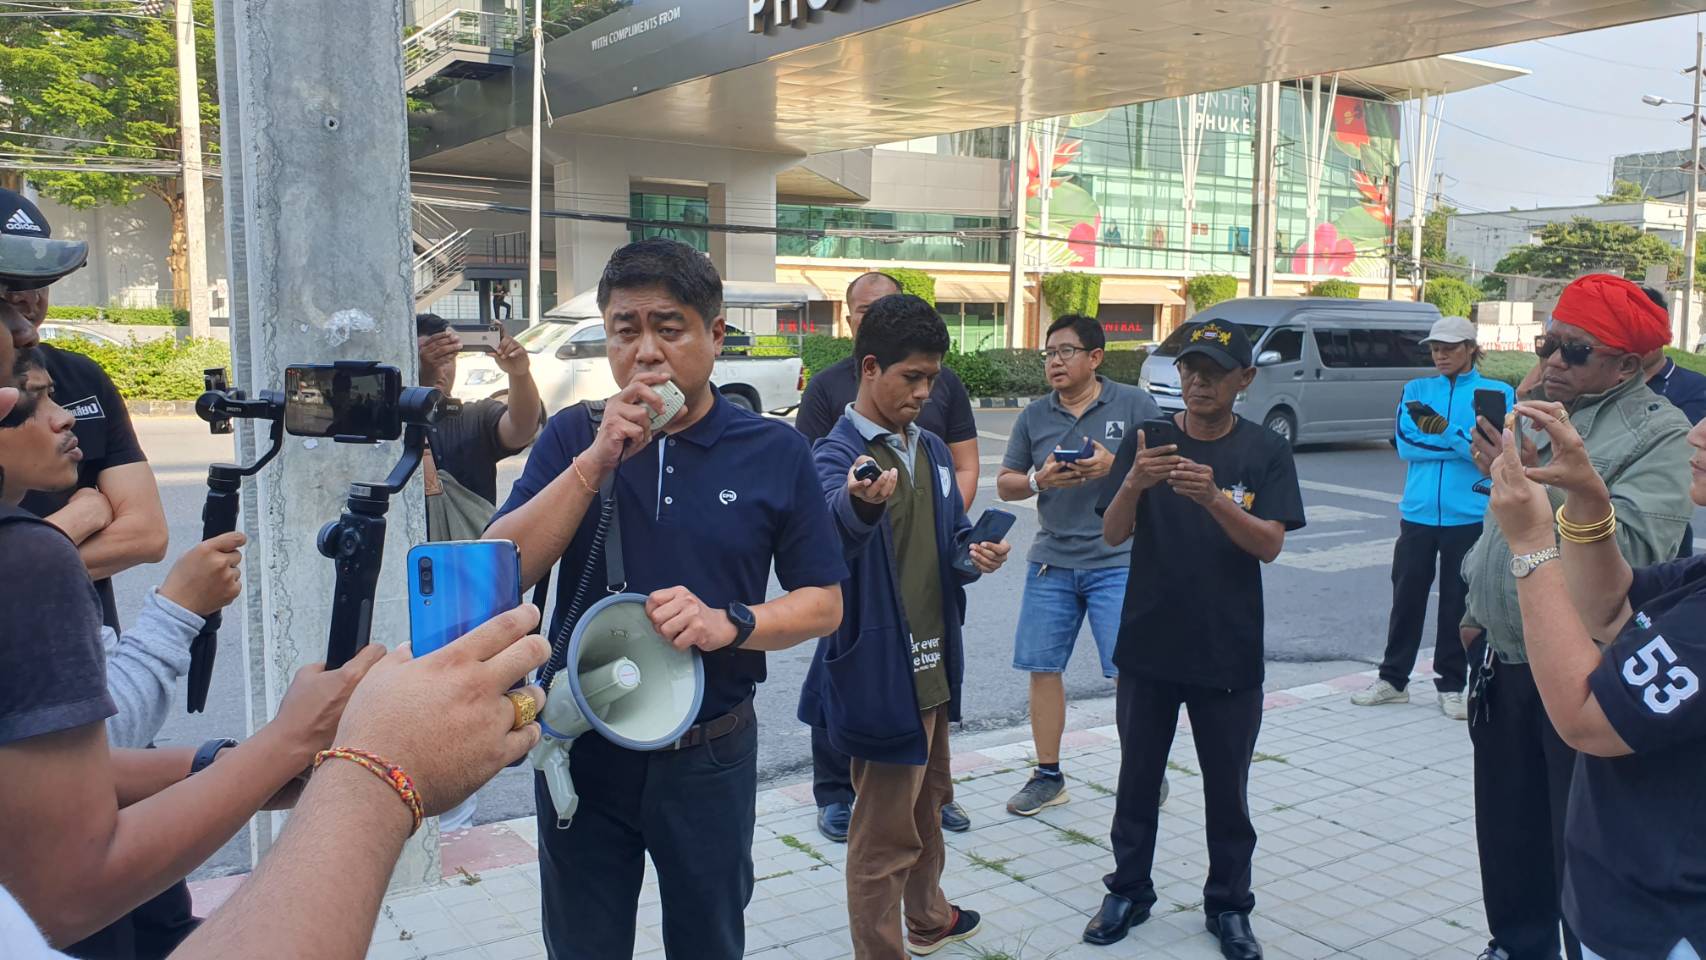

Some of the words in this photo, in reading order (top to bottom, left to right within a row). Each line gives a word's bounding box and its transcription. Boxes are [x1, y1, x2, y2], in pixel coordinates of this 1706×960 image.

[591, 34, 608, 51] WITH
[609, 16, 657, 44] COMPLIMENTS
[659, 6, 681, 26] FROM
[1195, 112, 1257, 135] PHUKE
[6, 223, 42, 231] adidas
[1622, 634, 1699, 714] 53
